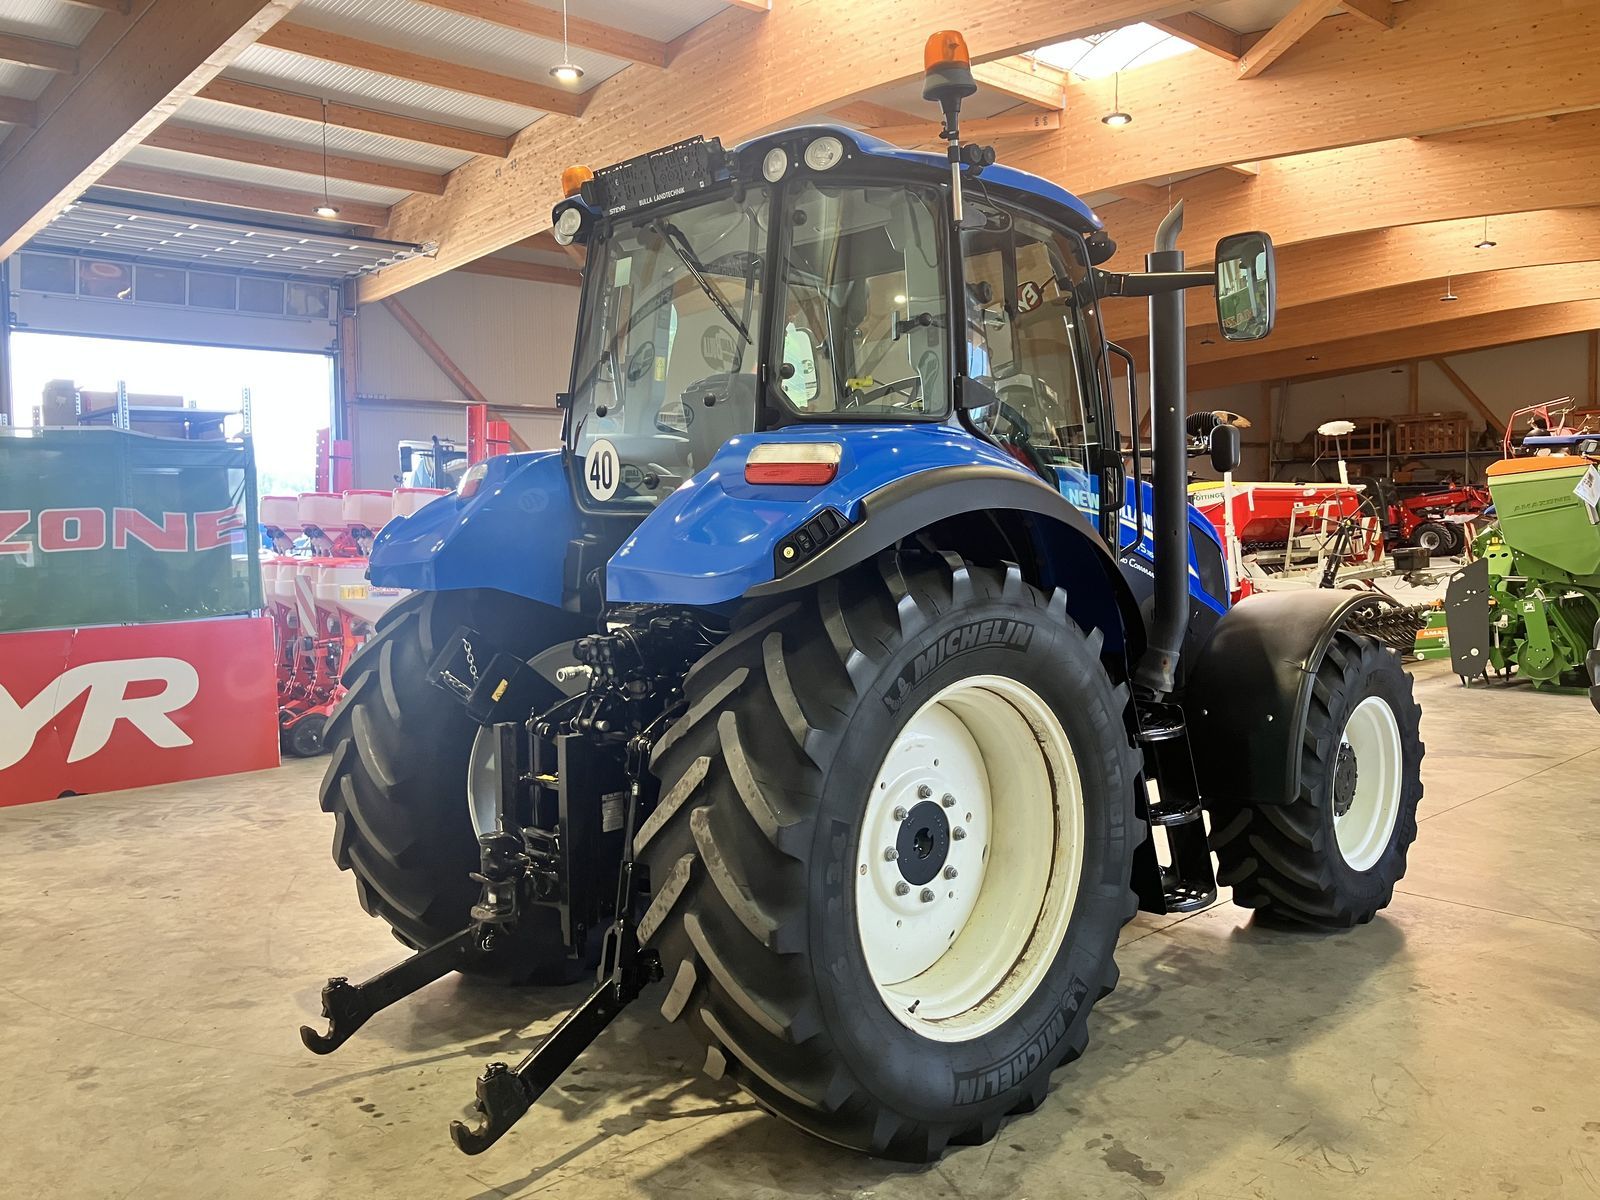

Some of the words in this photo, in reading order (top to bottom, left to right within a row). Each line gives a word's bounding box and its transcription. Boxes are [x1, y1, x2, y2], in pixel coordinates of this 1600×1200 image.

[609, 205, 626, 215] STEYR
[639, 197, 653, 206] BULLA
[653, 187, 685, 202] LANDTECHNIK
[590, 451, 612, 490] 40
[1068, 488, 1100, 510] NEW
[914, 621, 1033, 683] MICHELIN
[954, 1011, 1066, 1104] MICHELIN
